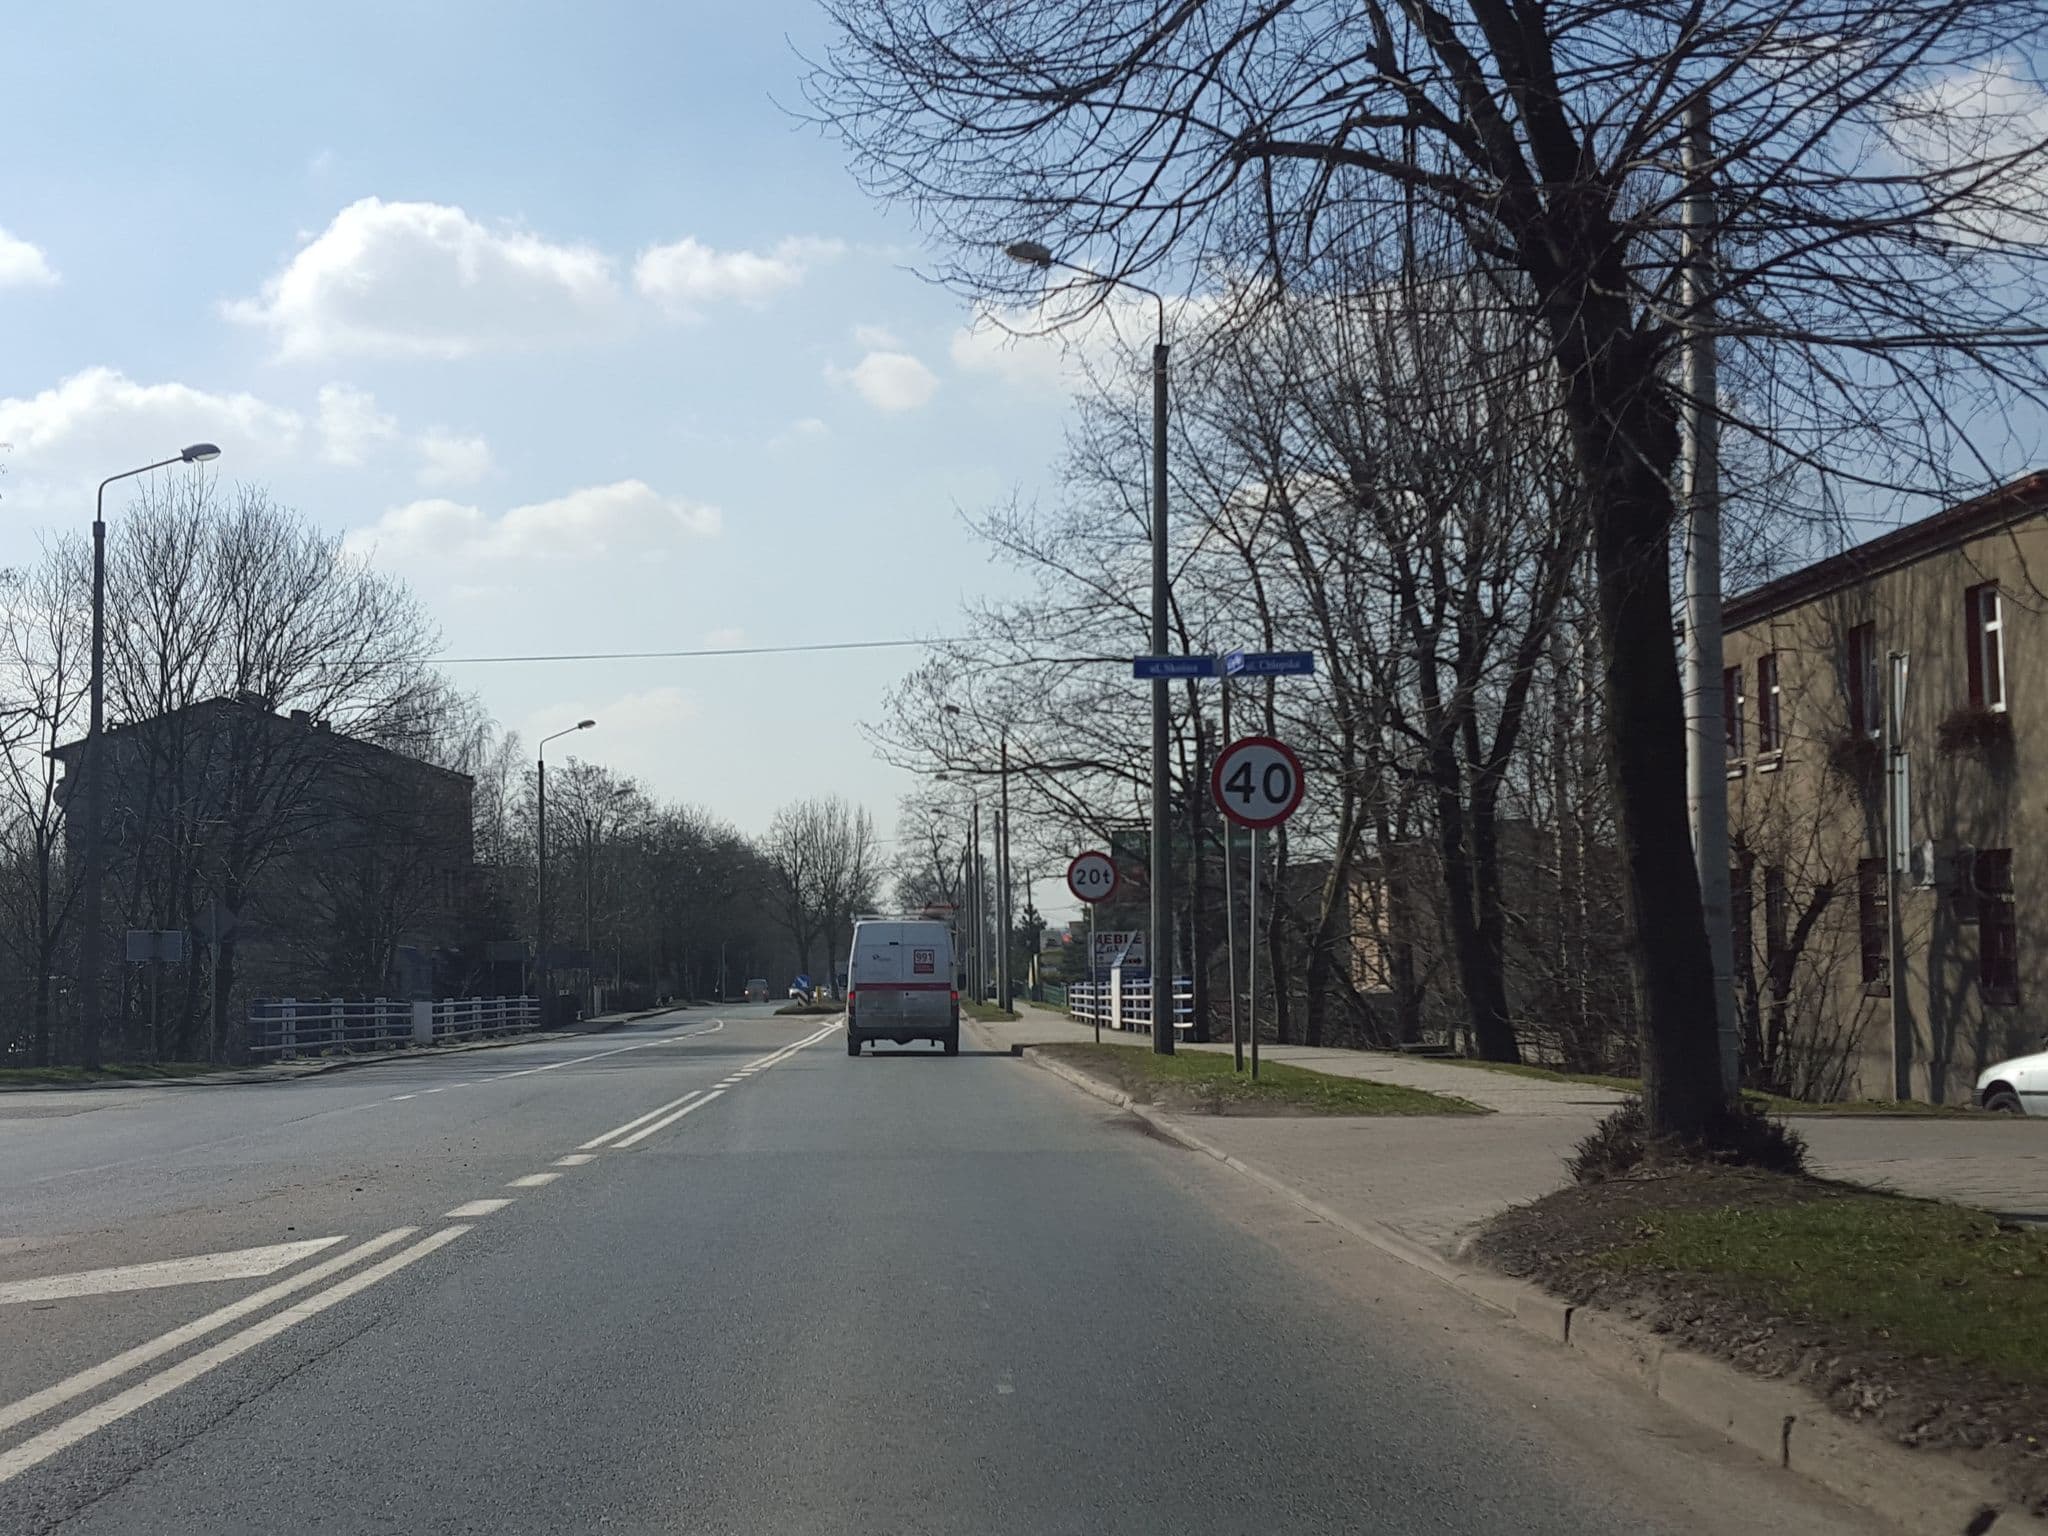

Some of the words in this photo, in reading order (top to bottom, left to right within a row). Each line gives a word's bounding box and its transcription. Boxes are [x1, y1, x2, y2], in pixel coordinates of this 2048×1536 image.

[1225, 761, 1292, 804] 40
[1076, 869, 1110, 885] 20t
[915, 951, 933, 962] 991
